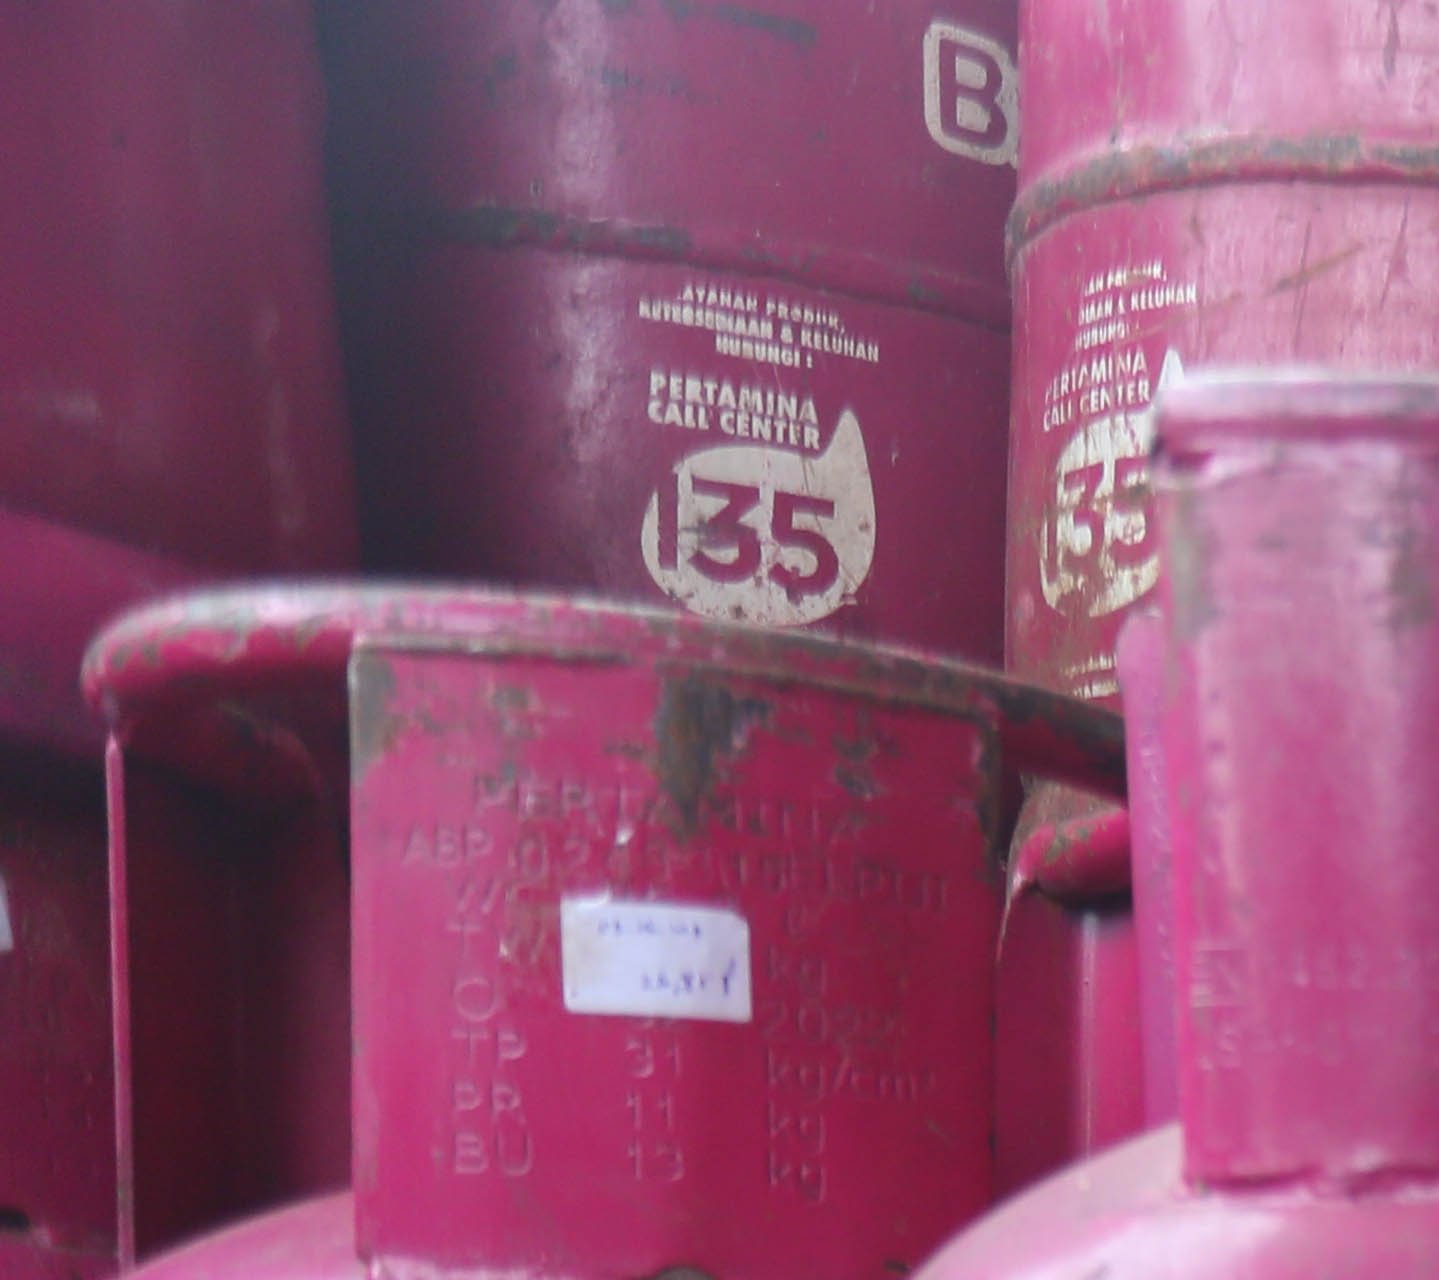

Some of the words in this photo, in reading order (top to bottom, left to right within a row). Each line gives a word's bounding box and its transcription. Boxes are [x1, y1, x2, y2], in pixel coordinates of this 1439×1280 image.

[801, 326, 880, 363] KELUHAN
[650, 366, 818, 426] PERTAMINA
[648, 399, 710, 431] CALL
[719, 410, 821, 450] CENTER
[655, 472, 842, 602] 135
